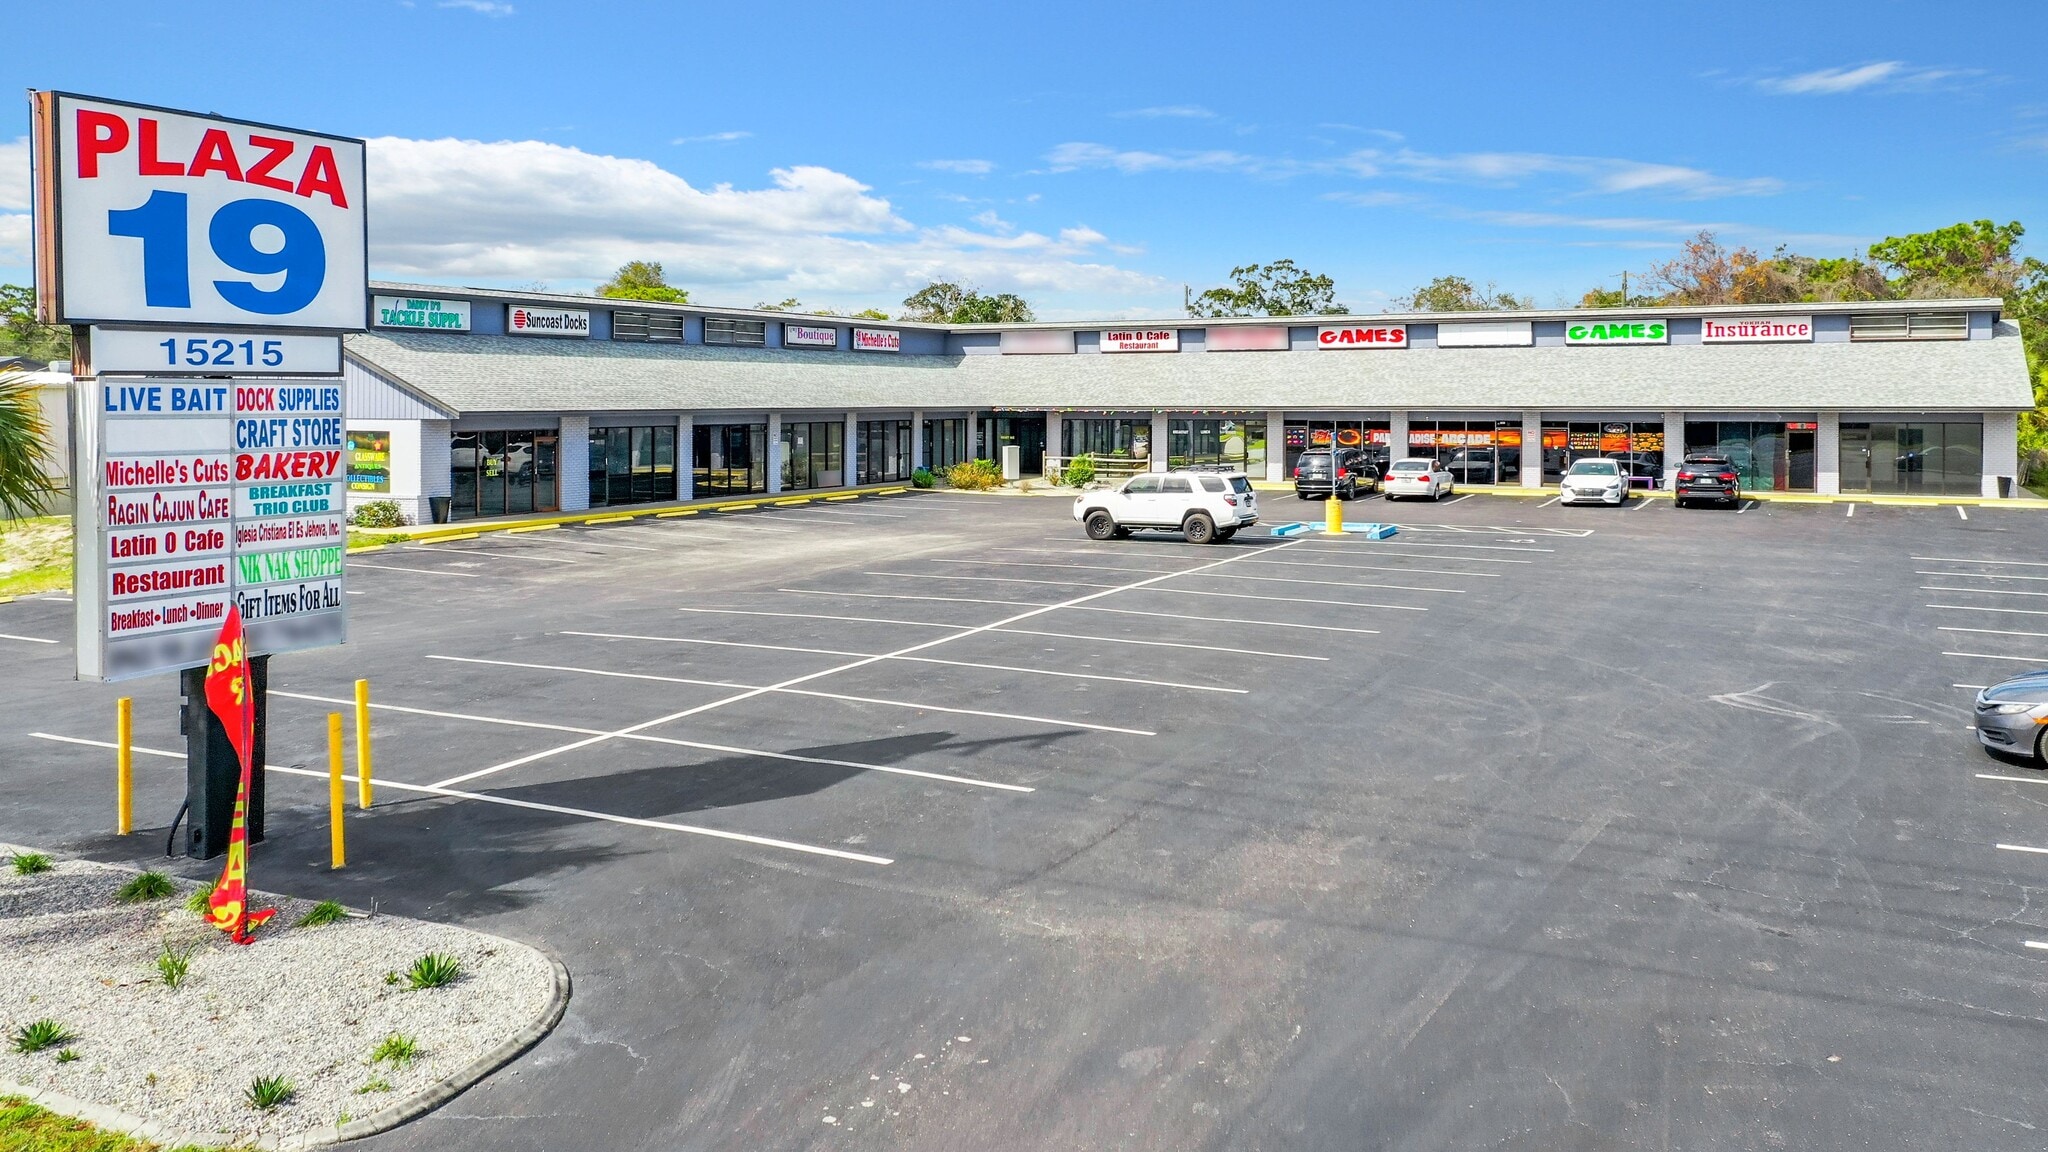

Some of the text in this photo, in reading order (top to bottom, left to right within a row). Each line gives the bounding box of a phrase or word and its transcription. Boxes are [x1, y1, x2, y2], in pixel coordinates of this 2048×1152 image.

[77, 109, 349, 209] PLAZA
[108, 189, 326, 315] 19
[381, 308, 425, 327] TACKLE
[526, 311, 588, 330] Suncoast Docks
[1705, 321, 1808, 338] Insurance
[797, 327, 834, 345] Boutique
[861, 331, 900, 349] Michelle's Cuts
[1108, 330, 1170, 341] Latin O Cafe
[1319, 329, 1405, 344] GAMES
[1568, 323, 1665, 340] GAMES
[160, 338, 283, 366] 15215
[1119, 341, 1158, 350] Restaurant
[105, 386, 227, 412] LIVE BAIT
[236, 387, 339, 411] DOCK SUPPLIES
[236, 418, 341, 449] CRAFT STORE
[106, 458, 229, 486] Michelle's Cuts
[235, 450, 341, 481] BAKERY
[249, 483, 332, 500] BREAKFAST
[346, 474, 384, 484] OLLECTIBLES
[108, 490, 229, 526] RAGIN CAJUN CAFE
[253, 498, 329, 516] TRIO CLUB
[111, 529, 224, 558] Latin O Cafe
[235, 524, 257, 548] Iglesia
[259, 522, 287, 542] Cristiana
[296, 521, 304, 538] Es
[305, 520, 328, 540] Jehova,
[328, 519, 340, 536] Inc.
[238, 547, 343, 585] NIK NAK SHOPPE
[113, 564, 225, 595] Restaurant
[237, 581, 341, 620] GIFT ITEMS FOR ALL
[111, 601, 224, 632] Breakfast Lunch Dinner
